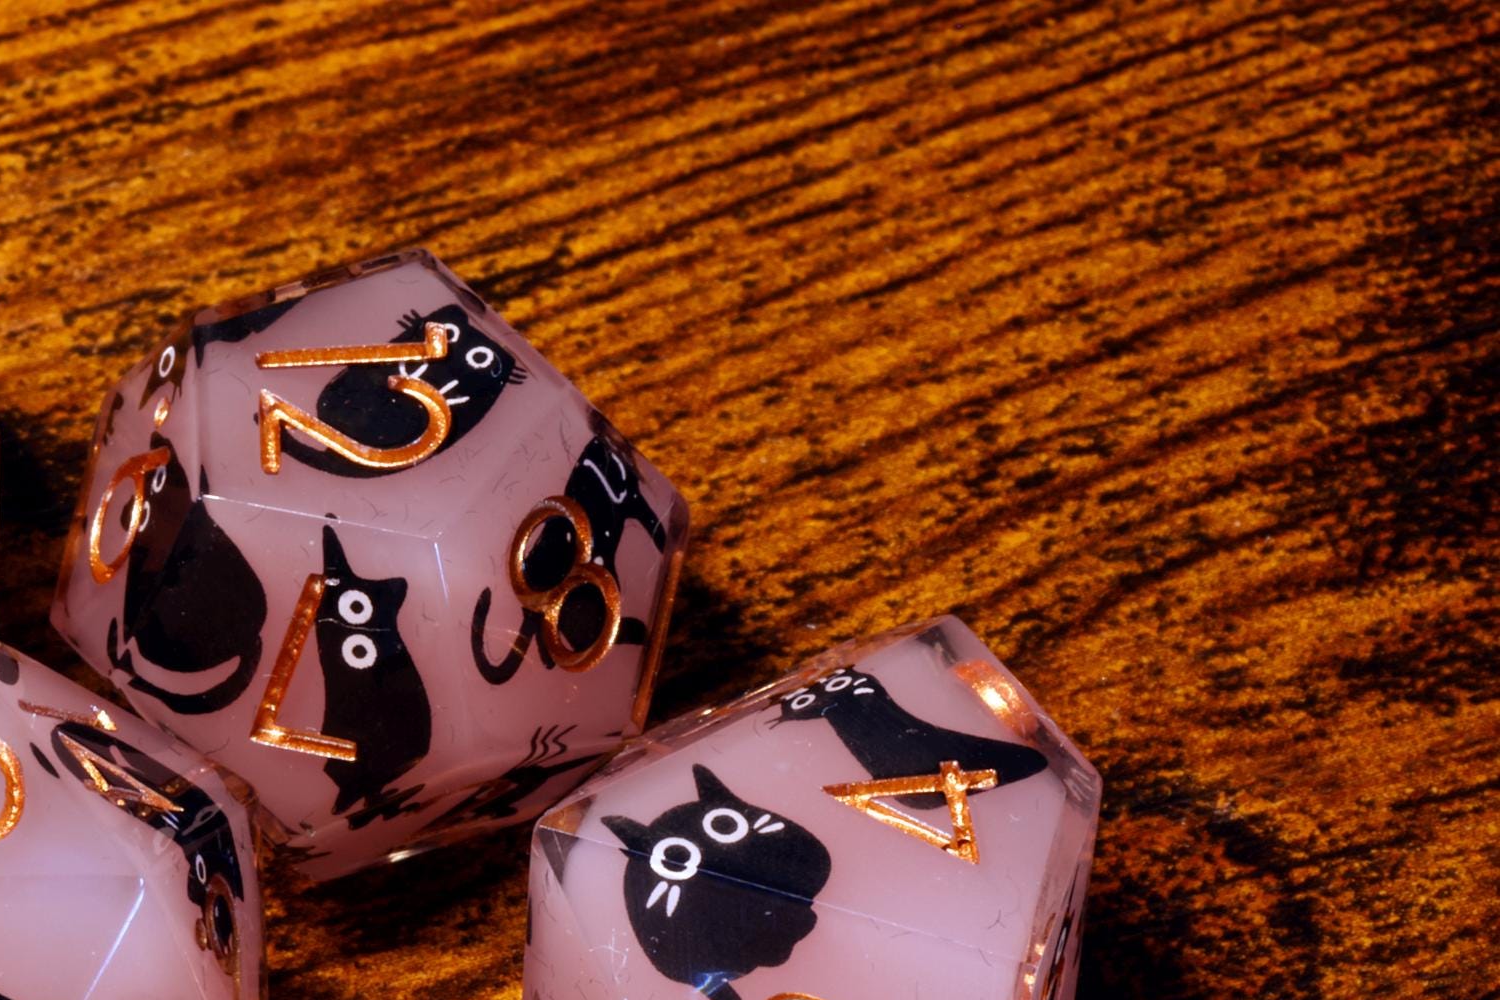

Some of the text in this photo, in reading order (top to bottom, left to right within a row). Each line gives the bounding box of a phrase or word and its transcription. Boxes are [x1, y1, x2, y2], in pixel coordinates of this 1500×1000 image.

[255, 320, 452, 476] 12
[508, 495, 624, 673] 8
[821, 759, 998, 865] 4
